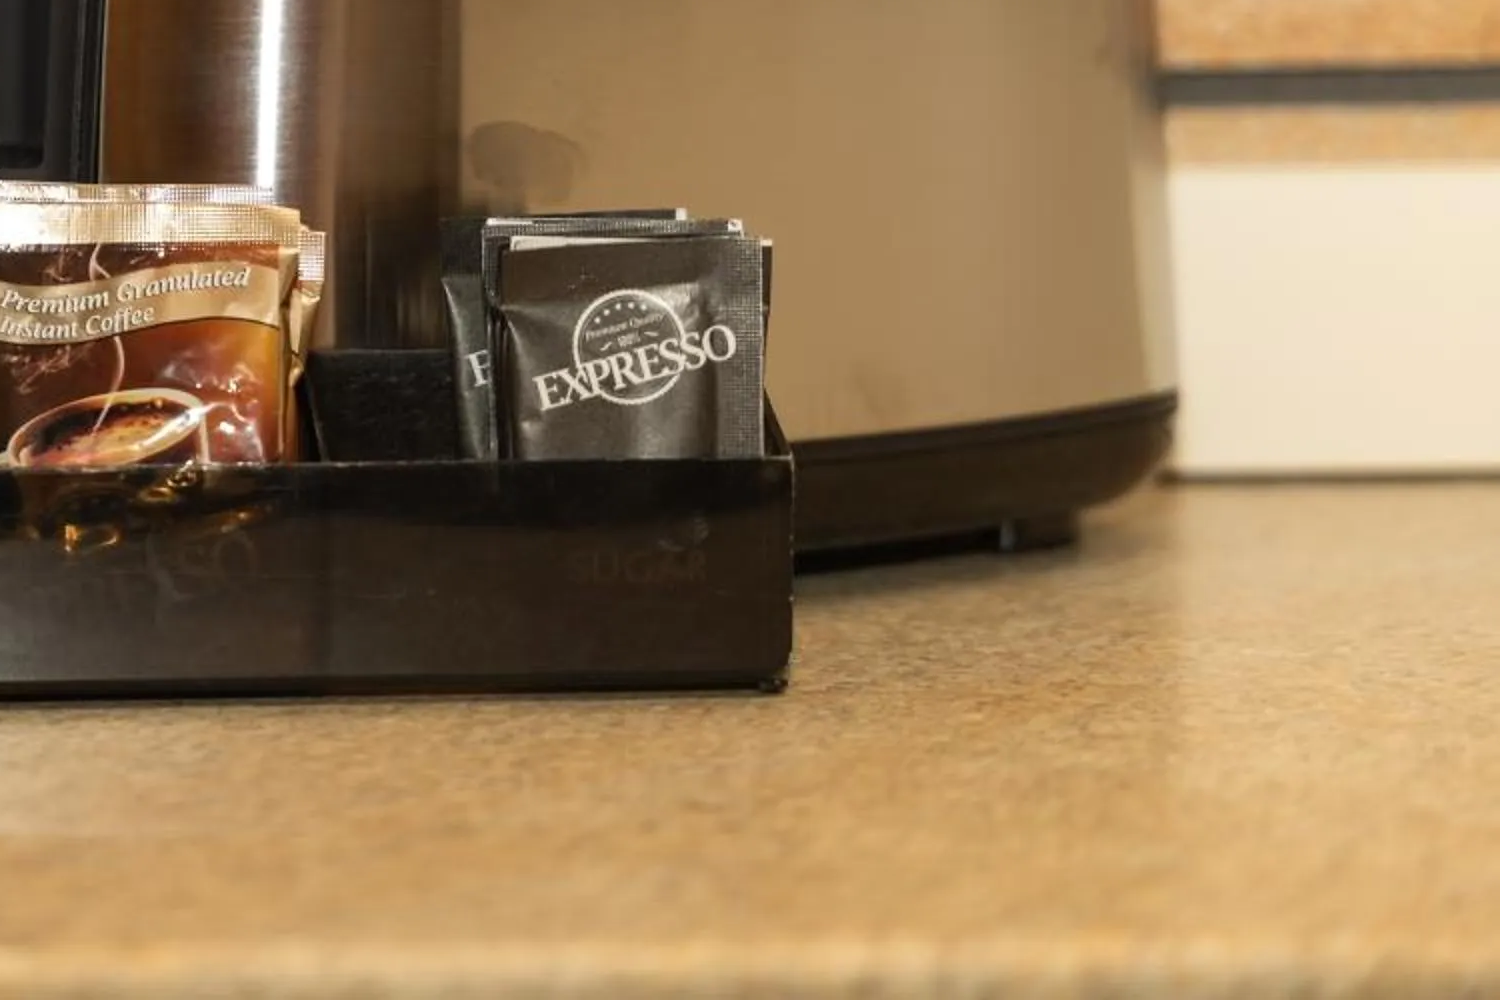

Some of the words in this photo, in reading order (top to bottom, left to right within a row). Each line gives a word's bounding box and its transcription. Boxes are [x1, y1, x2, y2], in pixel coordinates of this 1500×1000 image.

[0, 288, 109, 315] Premium
[116, 266, 252, 300] Granulated
[0, 316, 78, 340] Instant
[84, 304, 156, 337] Coffee
[531, 324, 738, 411] EXPRESSO
